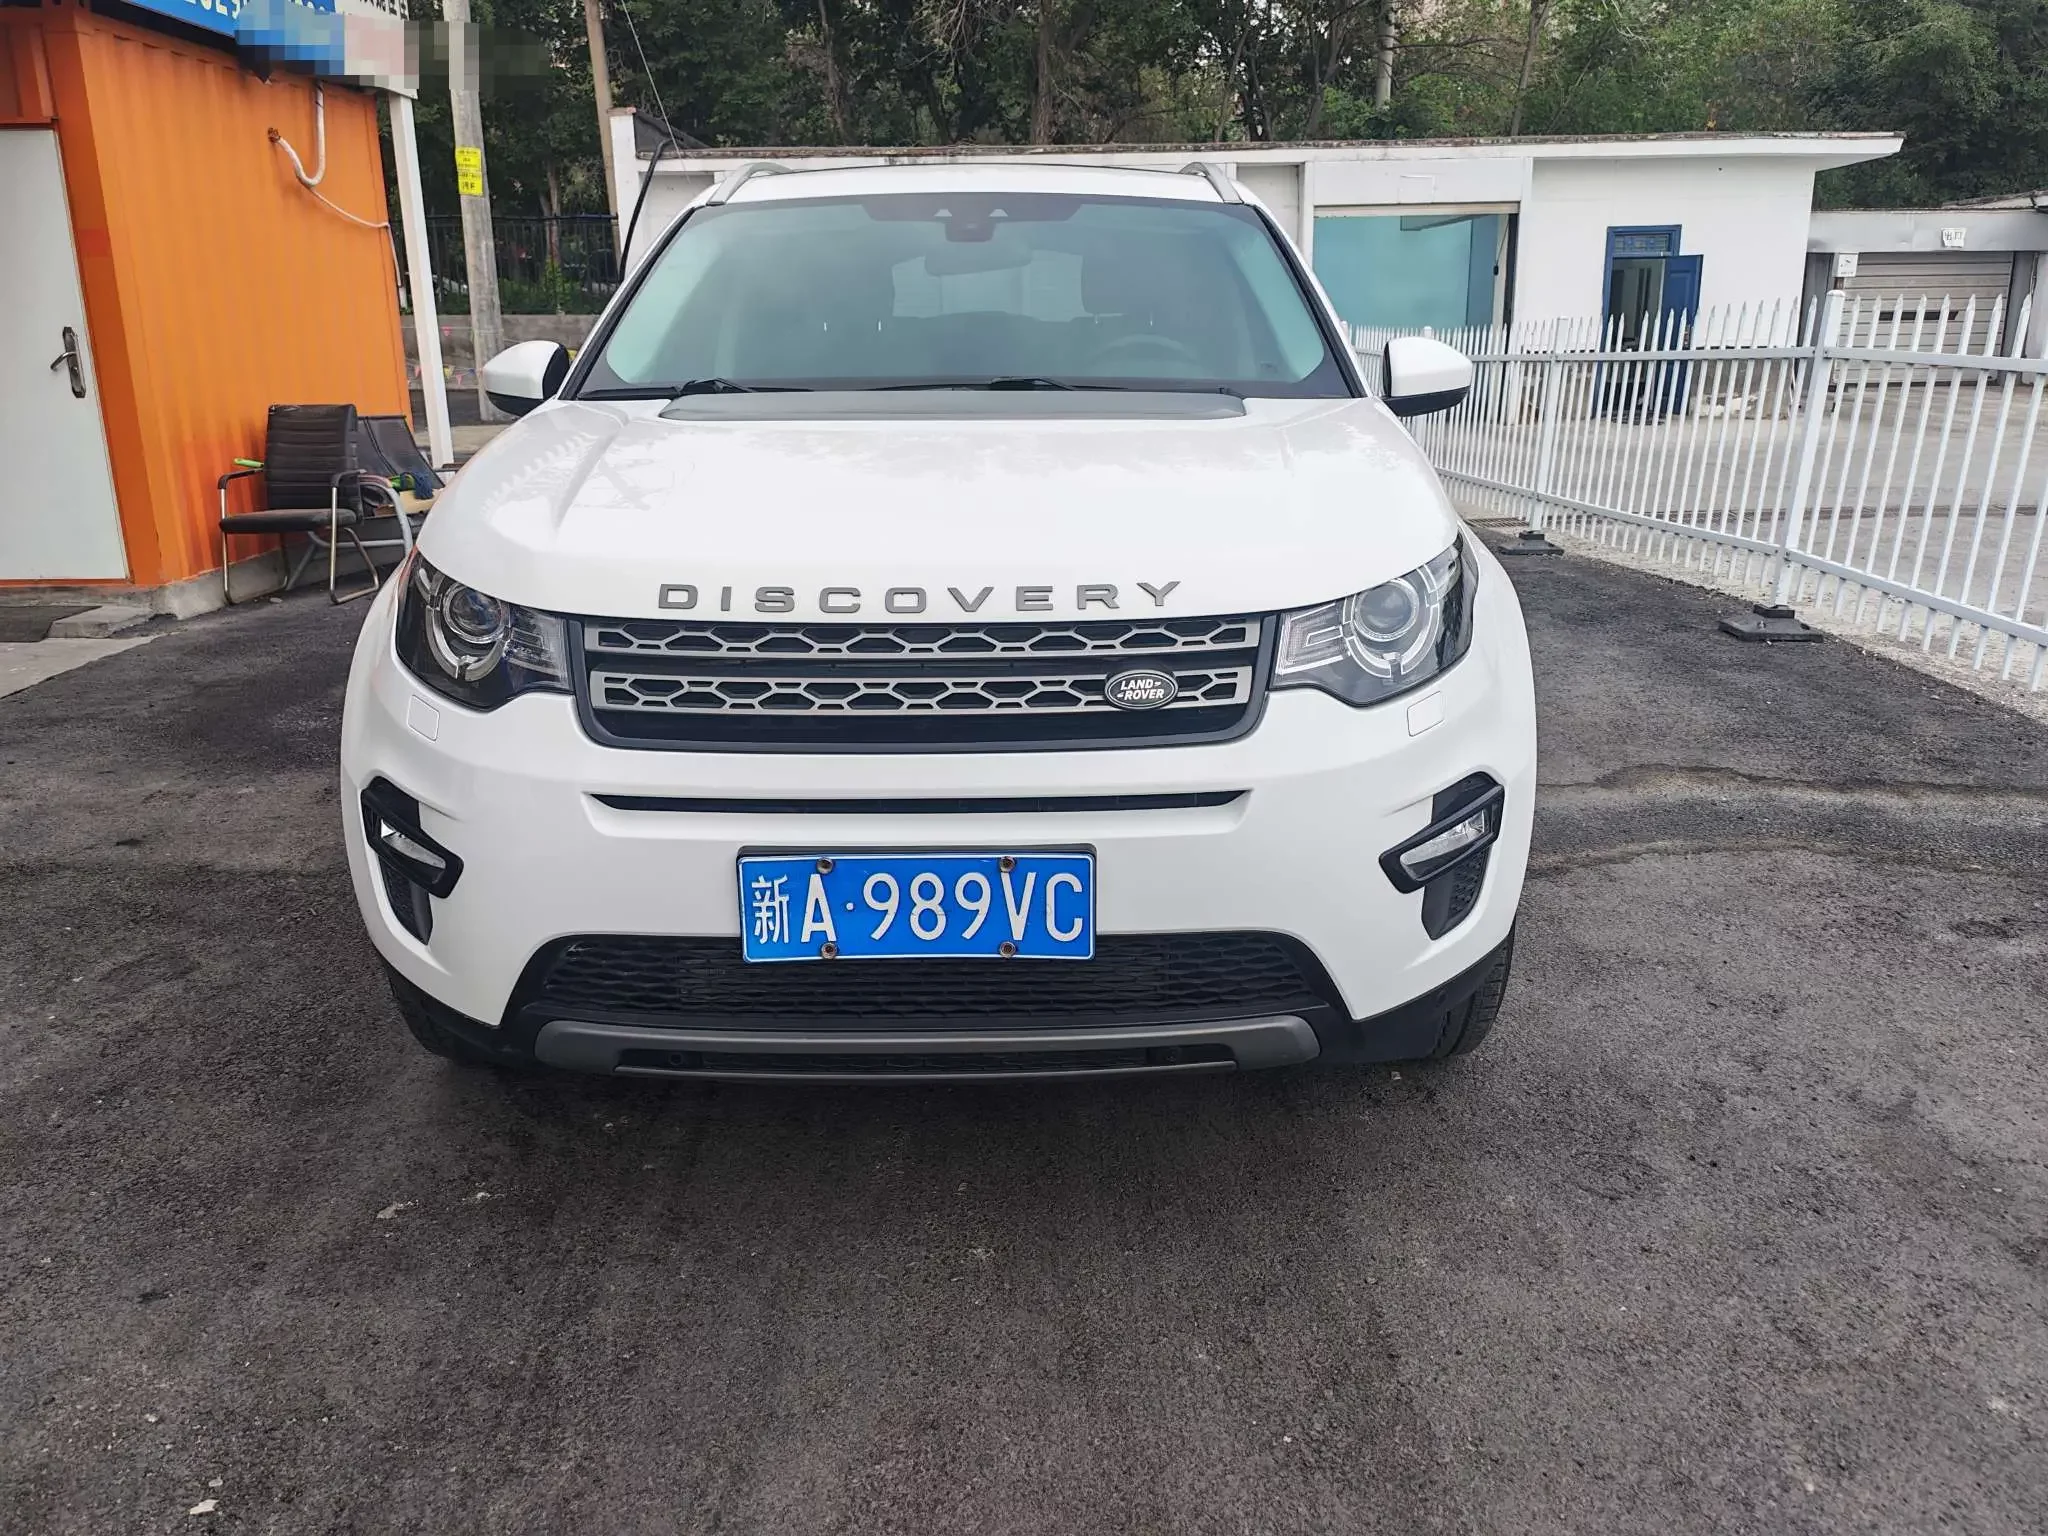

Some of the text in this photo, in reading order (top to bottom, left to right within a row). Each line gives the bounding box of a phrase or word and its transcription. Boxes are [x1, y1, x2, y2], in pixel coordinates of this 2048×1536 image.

[657, 580, 1182, 614] DISCOVERY
[1120, 679, 1154, 691] LAND
[1124, 688, 1165, 701] ROVER
